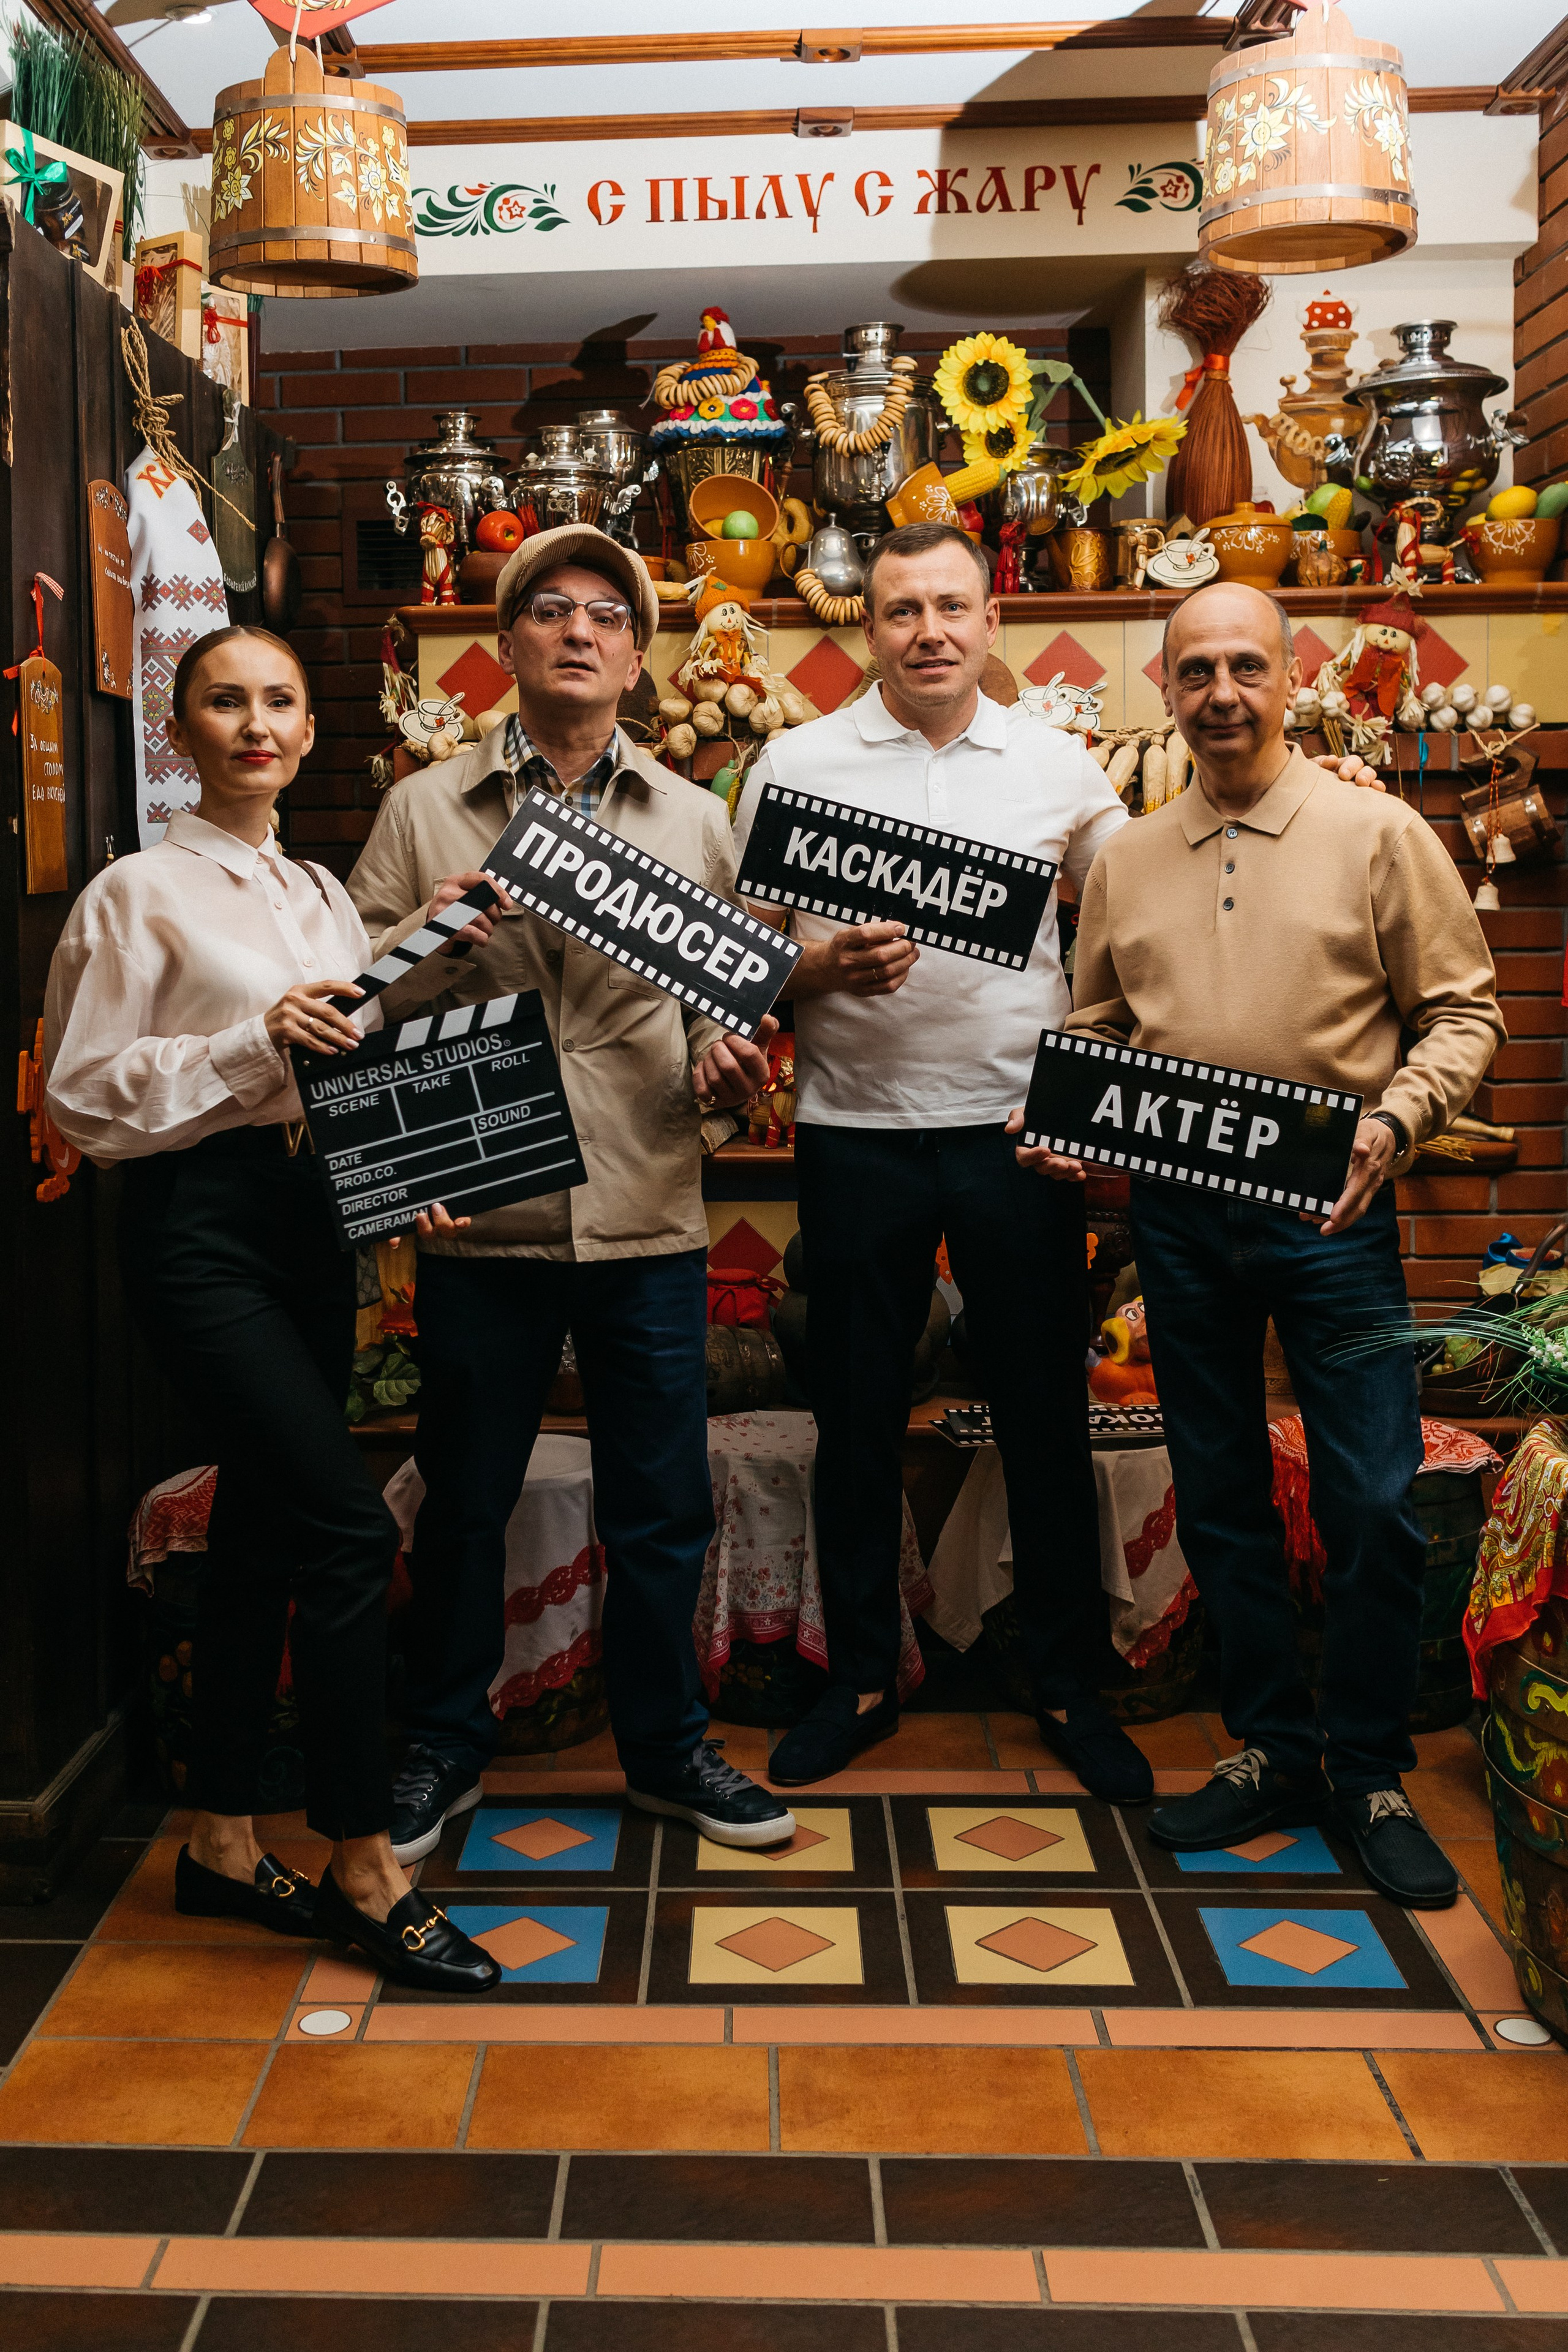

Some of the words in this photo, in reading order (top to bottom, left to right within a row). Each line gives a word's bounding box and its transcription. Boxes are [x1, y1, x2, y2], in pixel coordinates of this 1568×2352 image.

[586, 179, 626, 227] С
[644, 172, 835, 234] ПЫЛУ
[854, 170, 895, 217] С
[913, 162, 1102, 227] ЖАРУ
[783, 826, 1008, 919] КАСКАДЁР
[511, 821, 769, 989] ПРОДЮСЕР
[310, 1058, 418, 1101] UNIVERSAL
[328, 1093, 380, 1117] SCENE
[412, 1074, 451, 1095] TAKE
[491, 1053, 530, 1072] ROLL
[478, 1104, 532, 1131] SOUND
[1090, 1084, 1280, 1159] АКТЁР
[329, 1153, 363, 1172] DATE
[341, 1188, 408, 1216] DIRECTOR
